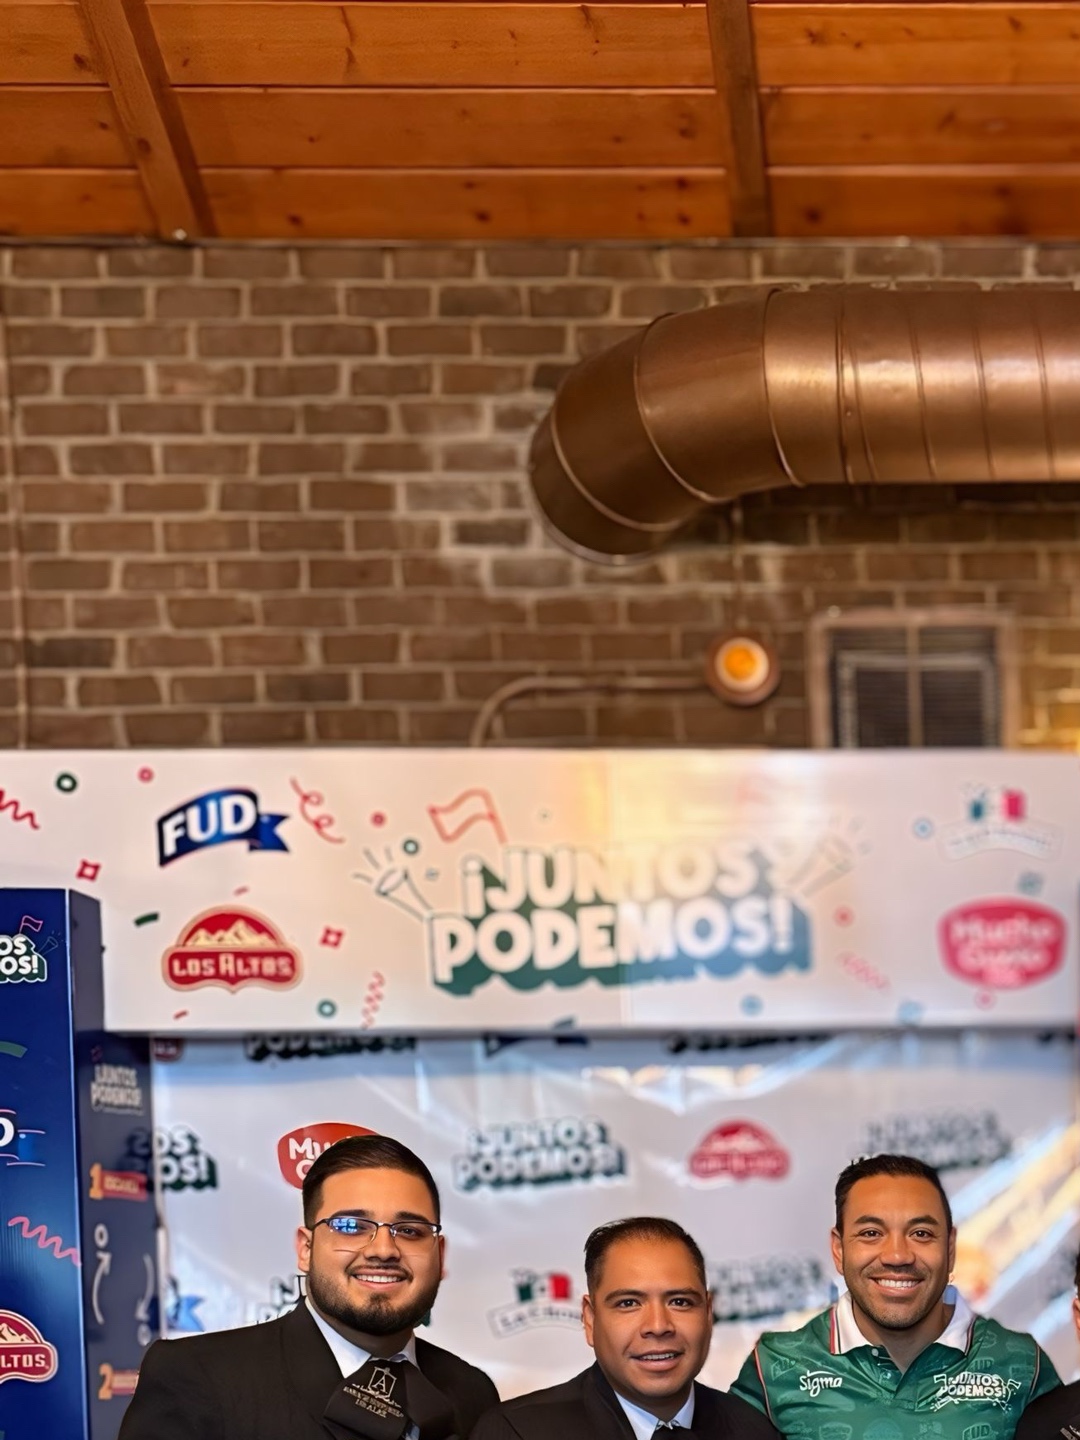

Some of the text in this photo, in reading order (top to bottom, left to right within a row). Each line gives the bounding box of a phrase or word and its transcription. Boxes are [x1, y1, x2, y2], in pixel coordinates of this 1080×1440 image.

[162, 794, 258, 857] FUD
[433, 896, 794, 983] PODEMOS!
[172, 952, 294, 977] LOS ALTOS
[799, 1373, 843, 1397] Sigma
